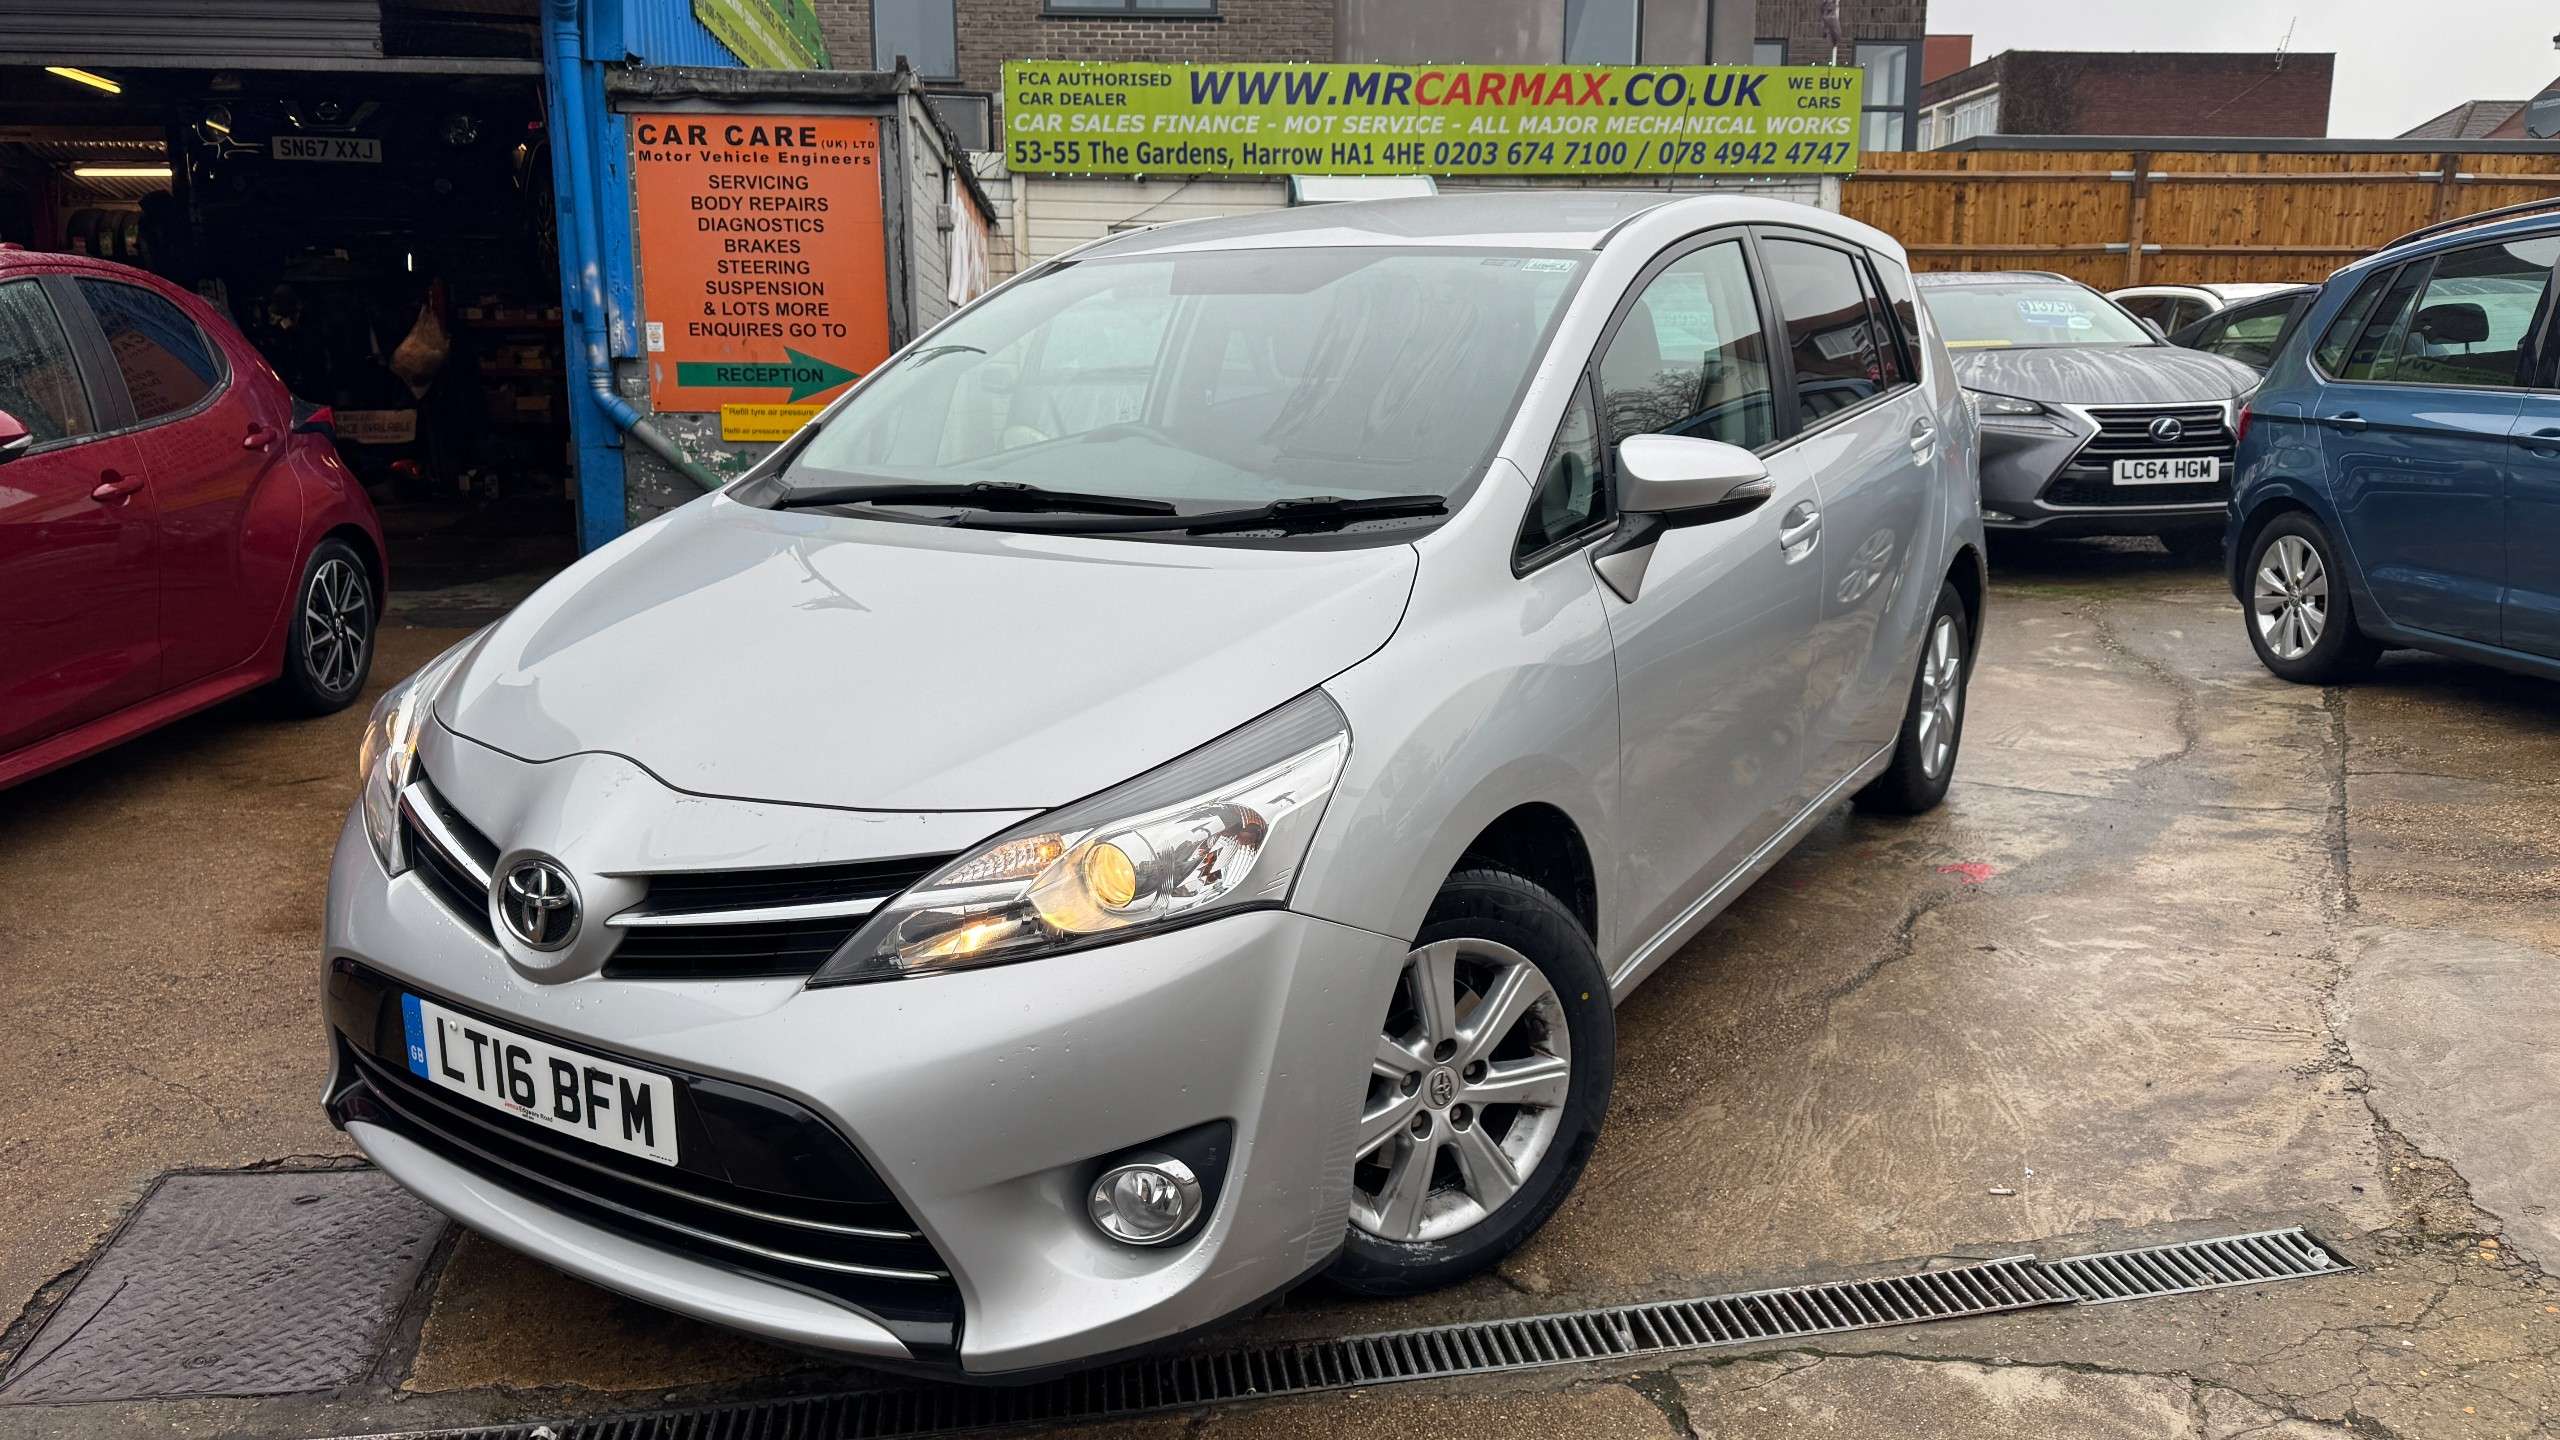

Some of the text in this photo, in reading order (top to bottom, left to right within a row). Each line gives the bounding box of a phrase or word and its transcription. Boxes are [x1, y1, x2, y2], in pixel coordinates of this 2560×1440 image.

[1018, 72, 1173, 87] FCA AUTHORISED
[1788, 76, 1853, 90] WE BUY
[1190, 71, 1768, 107] WWW.MRCARMAX.CO.UK
[1018, 92, 1127, 107] CAR DEALER
[1797, 96, 1841, 110] CARS
[1014, 113, 1064, 133] CAR
[1070, 113, 1146, 134] SALES
[1152, 115, 1260, 134] FINANCE
[1284, 115, 1338, 134] MOT
[1342, 116, 1446, 135] SERVICE
[1468, 116, 1510, 134] ALL
[1518, 116, 1598, 135] MAJOR
[1605, 116, 1757, 135] MECHANICAL
[1766, 116, 1852, 135] WORKS
[637, 124, 876, 150] CAR CARE (UK) LTD
[280, 139, 373, 159] SN67 XXJ
[1014, 140, 1851, 170] 53-55 The Gardens, Harrow HA1 4HE 0203 674 7100 / 078 4942 4747
[638, 151, 872, 167] Motor Vehicle Engineers
[708, 174, 809, 190] SERVICING
[691, 196, 829, 212] BODY REPAIRS
[698, 218, 825, 233] DIAGNOSTICS
[724, 239, 801, 254] BRAKES
[717, 260, 810, 275] STEERING
[706, 281, 824, 296] SUSPENSION
[703, 301, 829, 317] & LOTS MORE
[689, 322, 847, 338] ENQUIRES GO TO
[717, 367, 824, 383] RECEPTION
[2121, 459, 2212, 480] LC64 HGM
[410, 1044, 424, 1063] GB
[436, 1017, 655, 1148] LT16 BFM
